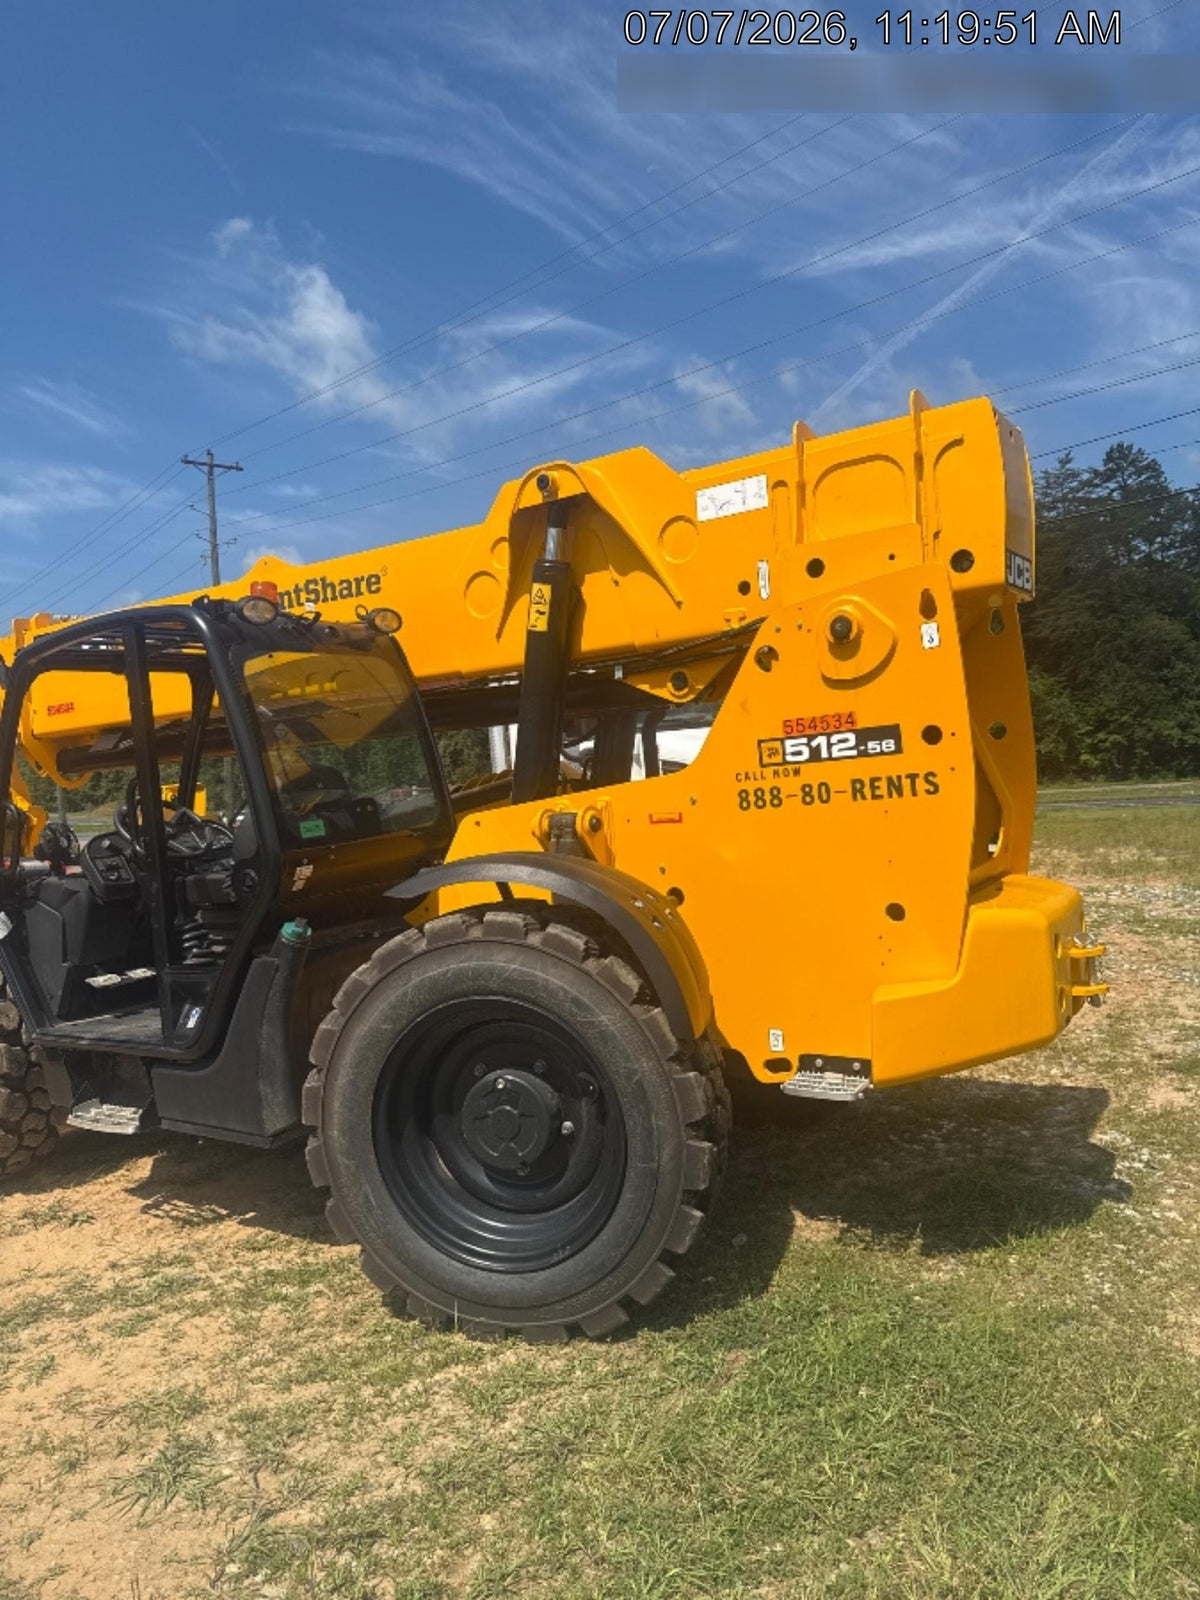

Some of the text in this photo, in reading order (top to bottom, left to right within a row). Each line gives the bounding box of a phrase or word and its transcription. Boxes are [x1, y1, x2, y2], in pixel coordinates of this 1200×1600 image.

[1007, 553, 1032, 591] JCB
[279, 574, 382, 610] ntShare
[783, 711, 856, 735] 554534
[735, 766, 801, 783] CALL NOW
[737, 771, 940, 811] 888-80-RENTS
